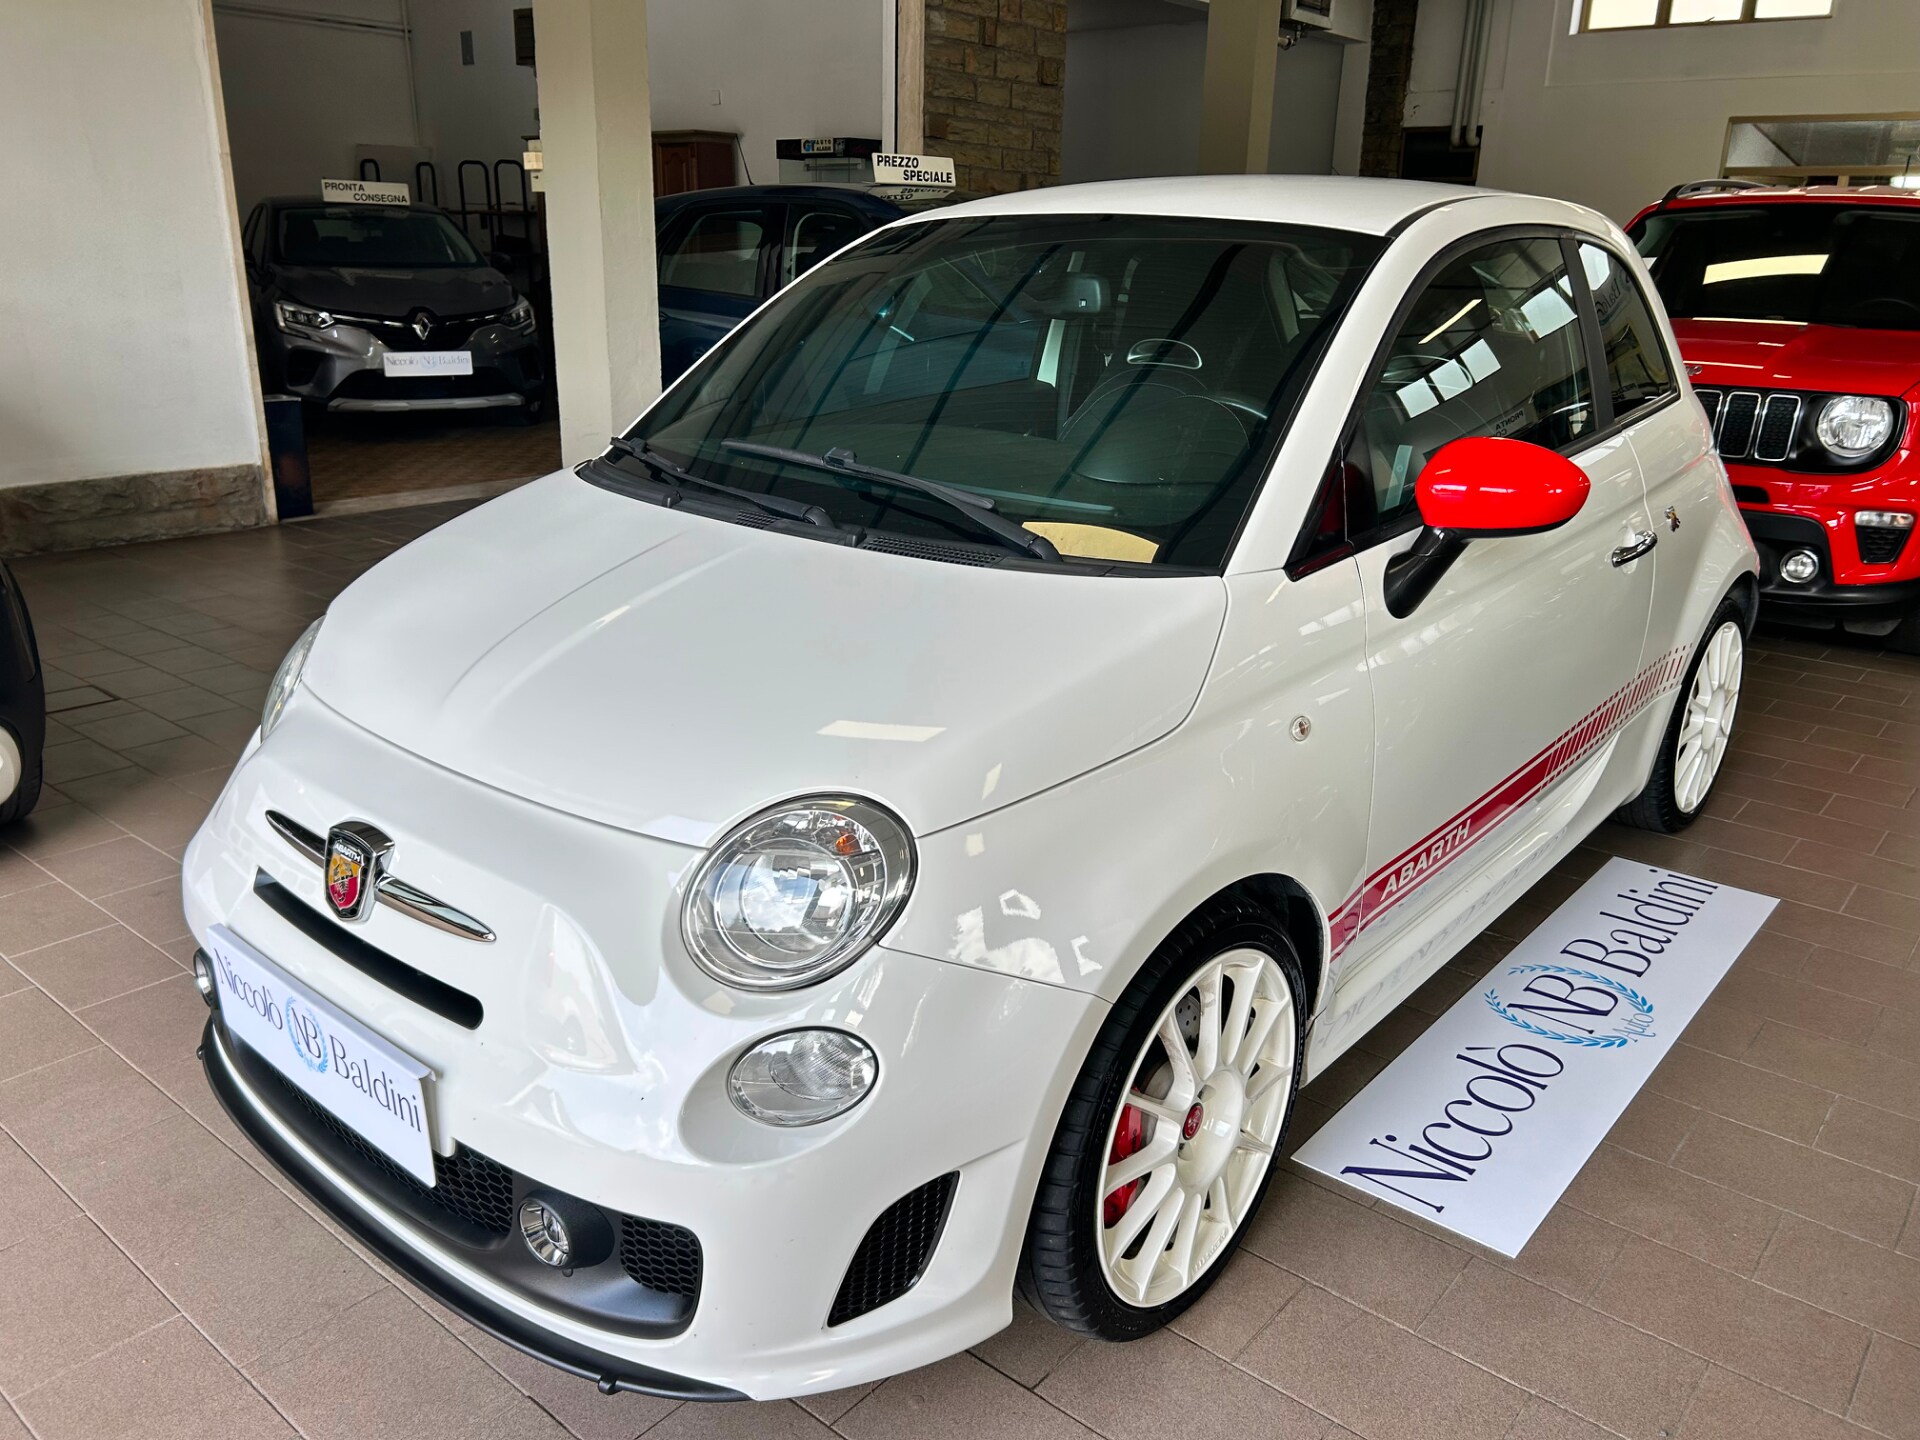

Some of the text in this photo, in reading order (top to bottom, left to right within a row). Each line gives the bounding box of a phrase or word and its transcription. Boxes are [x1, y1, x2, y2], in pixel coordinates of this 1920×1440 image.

[876, 154, 919, 169] PREZZO
[903, 169, 953, 183] SPECIALE
[323, 181, 365, 192] PRONTA
[353, 192, 408, 203] CONSEGNA
[334, 842, 361, 862] ABARTH
[1380, 818, 1472, 902] ABARTH
[1559, 868, 1719, 978] Baldini
[1506, 974, 1619, 1035] NB
[213, 947, 422, 1133] Niccolò NB Baldini
[1612, 1012, 1656, 1043] Auto
[1340, 1042, 1564, 1213] Niccolò
